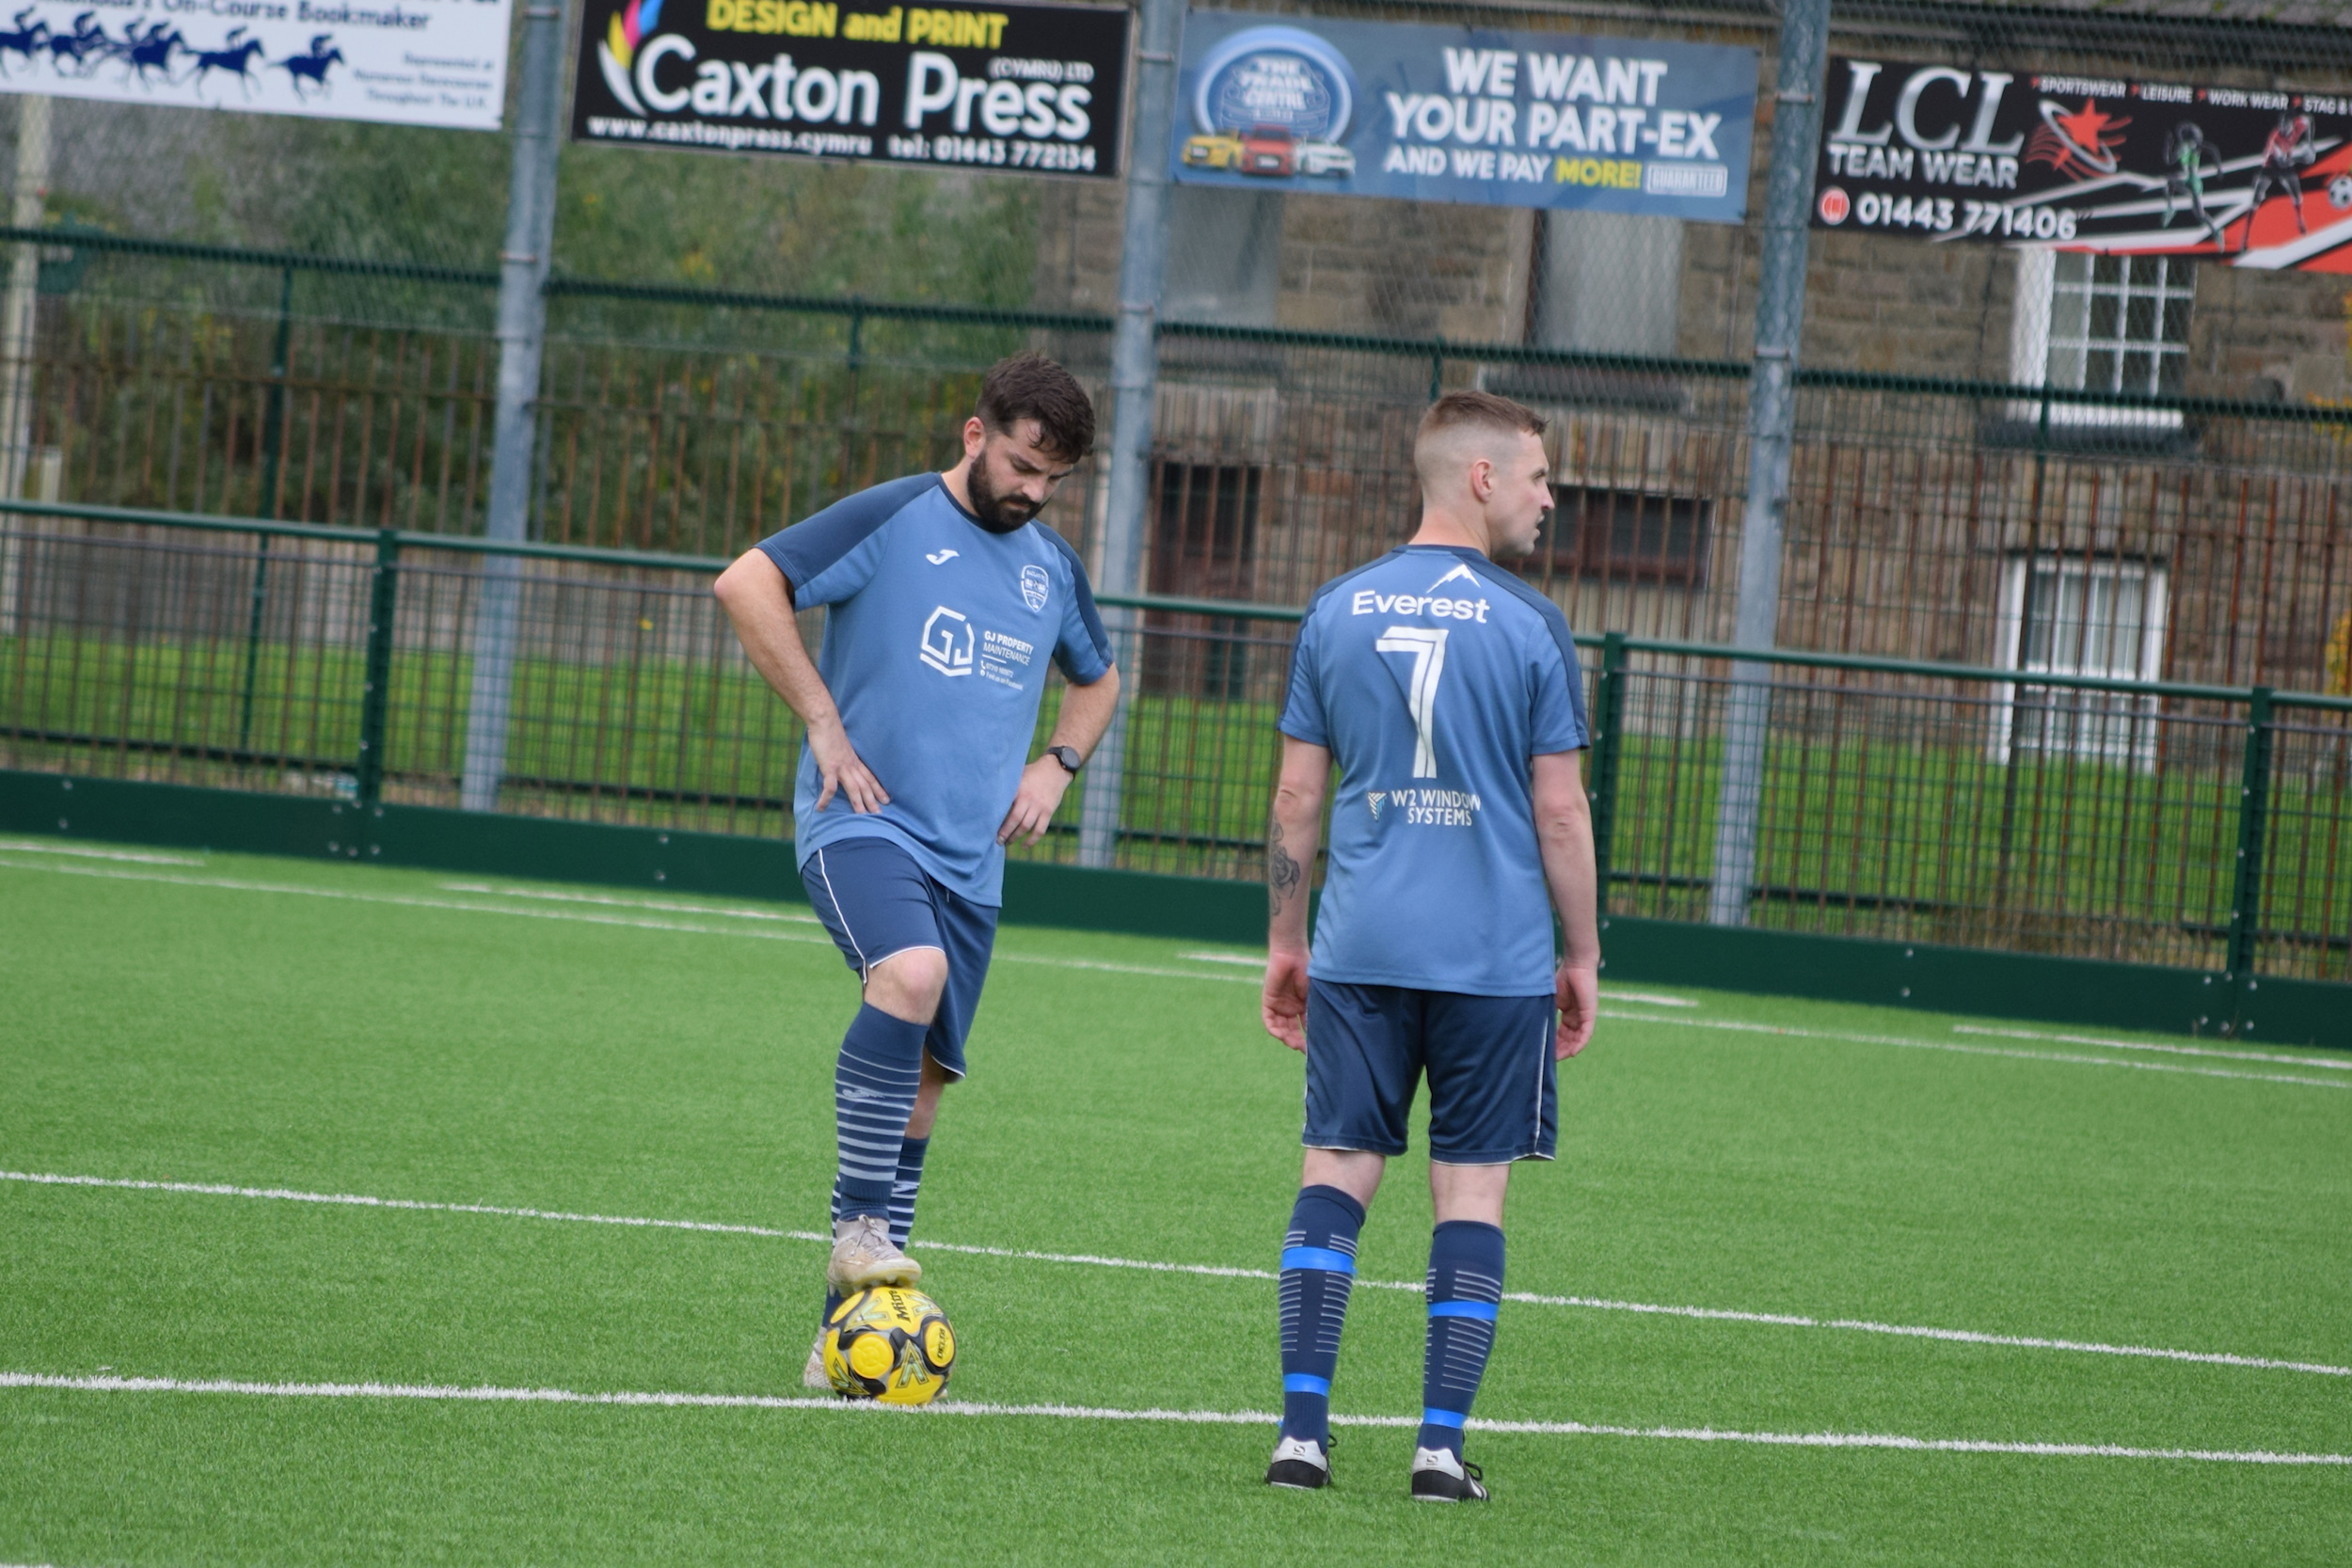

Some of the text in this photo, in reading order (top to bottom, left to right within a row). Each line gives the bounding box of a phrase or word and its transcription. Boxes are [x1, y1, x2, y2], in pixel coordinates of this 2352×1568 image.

[296, 1, 430, 30] Bookmaker
[707, 0, 1009, 50] DESIGN and PRINT
[636, 34, 1092, 140] Caxton Press
[990, 58, 1094, 83] (CYMRU) LTD
[1442, 47, 1667, 105] WE WANT
[1830, 60, 2025, 155] LCL
[2039, 76, 2128, 99] SPORTSWEAR
[2140, 87, 2193, 103] LEISURE
[2208, 89, 2248, 107] WORK
[2249, 92, 2289, 111] WEAR
[2304, 96, 2336, 114] STAG
[588, 115, 873, 156] www.caxtonpress.cymru
[1386, 93, 1722, 160] YOUR PART-EX
[888, 135, 1096, 173] tel: 01443 772134
[1384, 144, 1643, 188] AND WE PAY MORE!
[1827, 144, 2019, 189] TEAM WEAR
[1652, 168, 1724, 192] GUARANTEED
[1856, 194, 2077, 241] 01443 771406
[1352, 591, 1490, 624] Everest
[983, 641, 1031, 666] MAINTENANCE
[984, 630, 1034, 655] GJ PROPERTY
[1375, 626, 1450, 779] 7
[1391, 788, 1481, 812] W2 WINDOW
[1407, 807, 1473, 827] SYSTEMS
